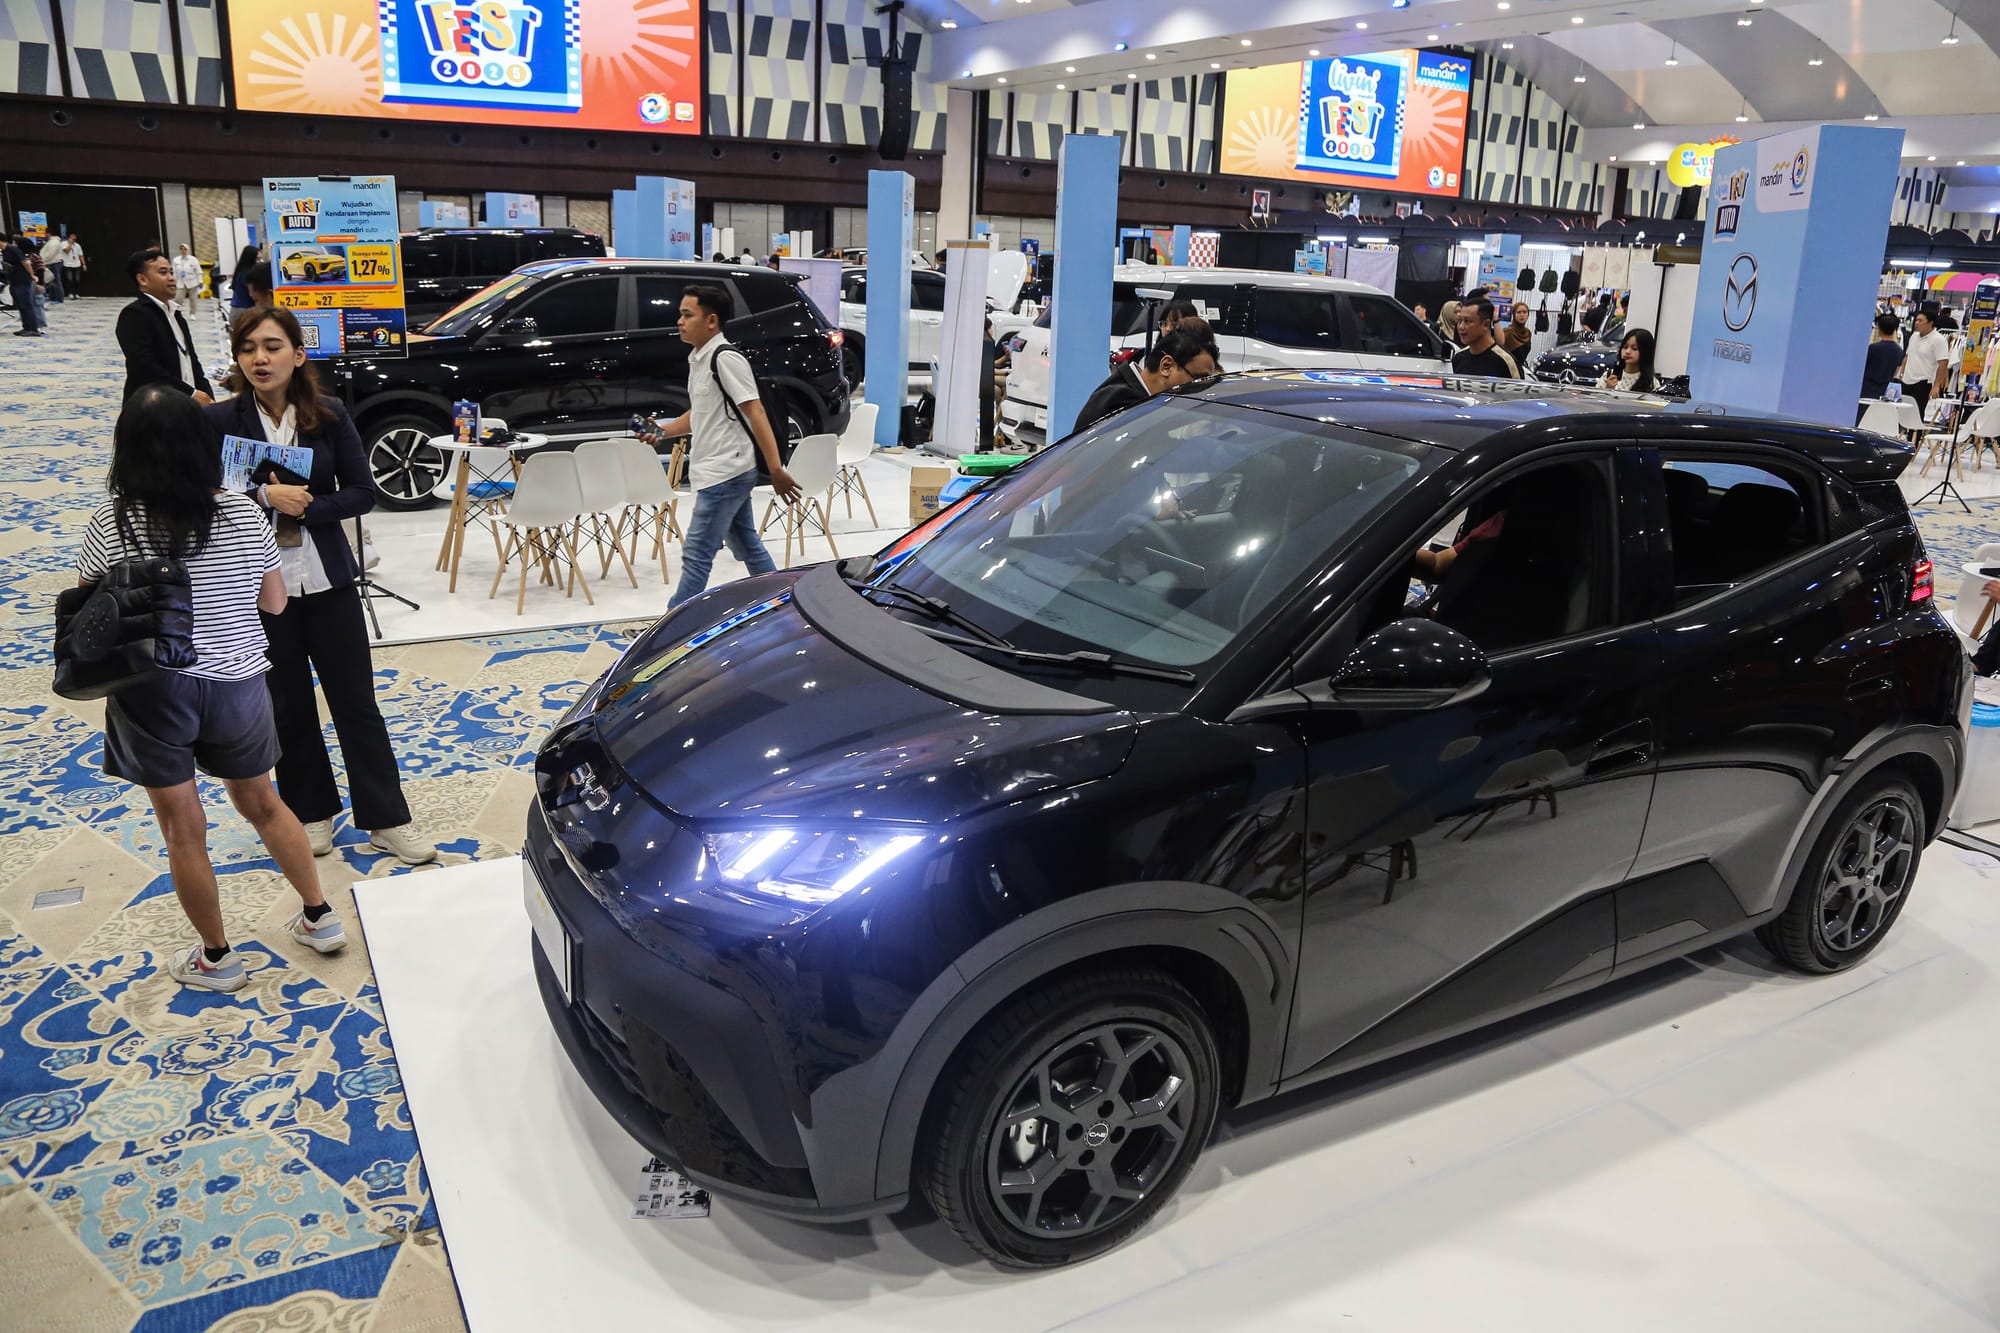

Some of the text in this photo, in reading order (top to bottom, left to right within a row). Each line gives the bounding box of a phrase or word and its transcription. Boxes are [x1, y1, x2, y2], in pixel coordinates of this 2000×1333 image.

[419, 0, 538, 58] FEST
[437, 59, 527, 82] 2025
[1420, 66, 1457, 80] mandiri
[1321, 100, 1382, 139] FEST
[1760, 171, 1783, 187] mandiri
[353, 182, 380, 190] mandiri
[341, 201, 373, 209] Wujudkan
[359, 210, 391, 218] Impianmu
[1719, 207, 1736, 231] AUTO
[288, 216, 312, 228] AUTO
[347, 218, 370, 226] dengan
[285, 296, 299, 308] 2,7
[322, 295, 333, 306] 27
[1713, 339, 1752, 364] mazda
